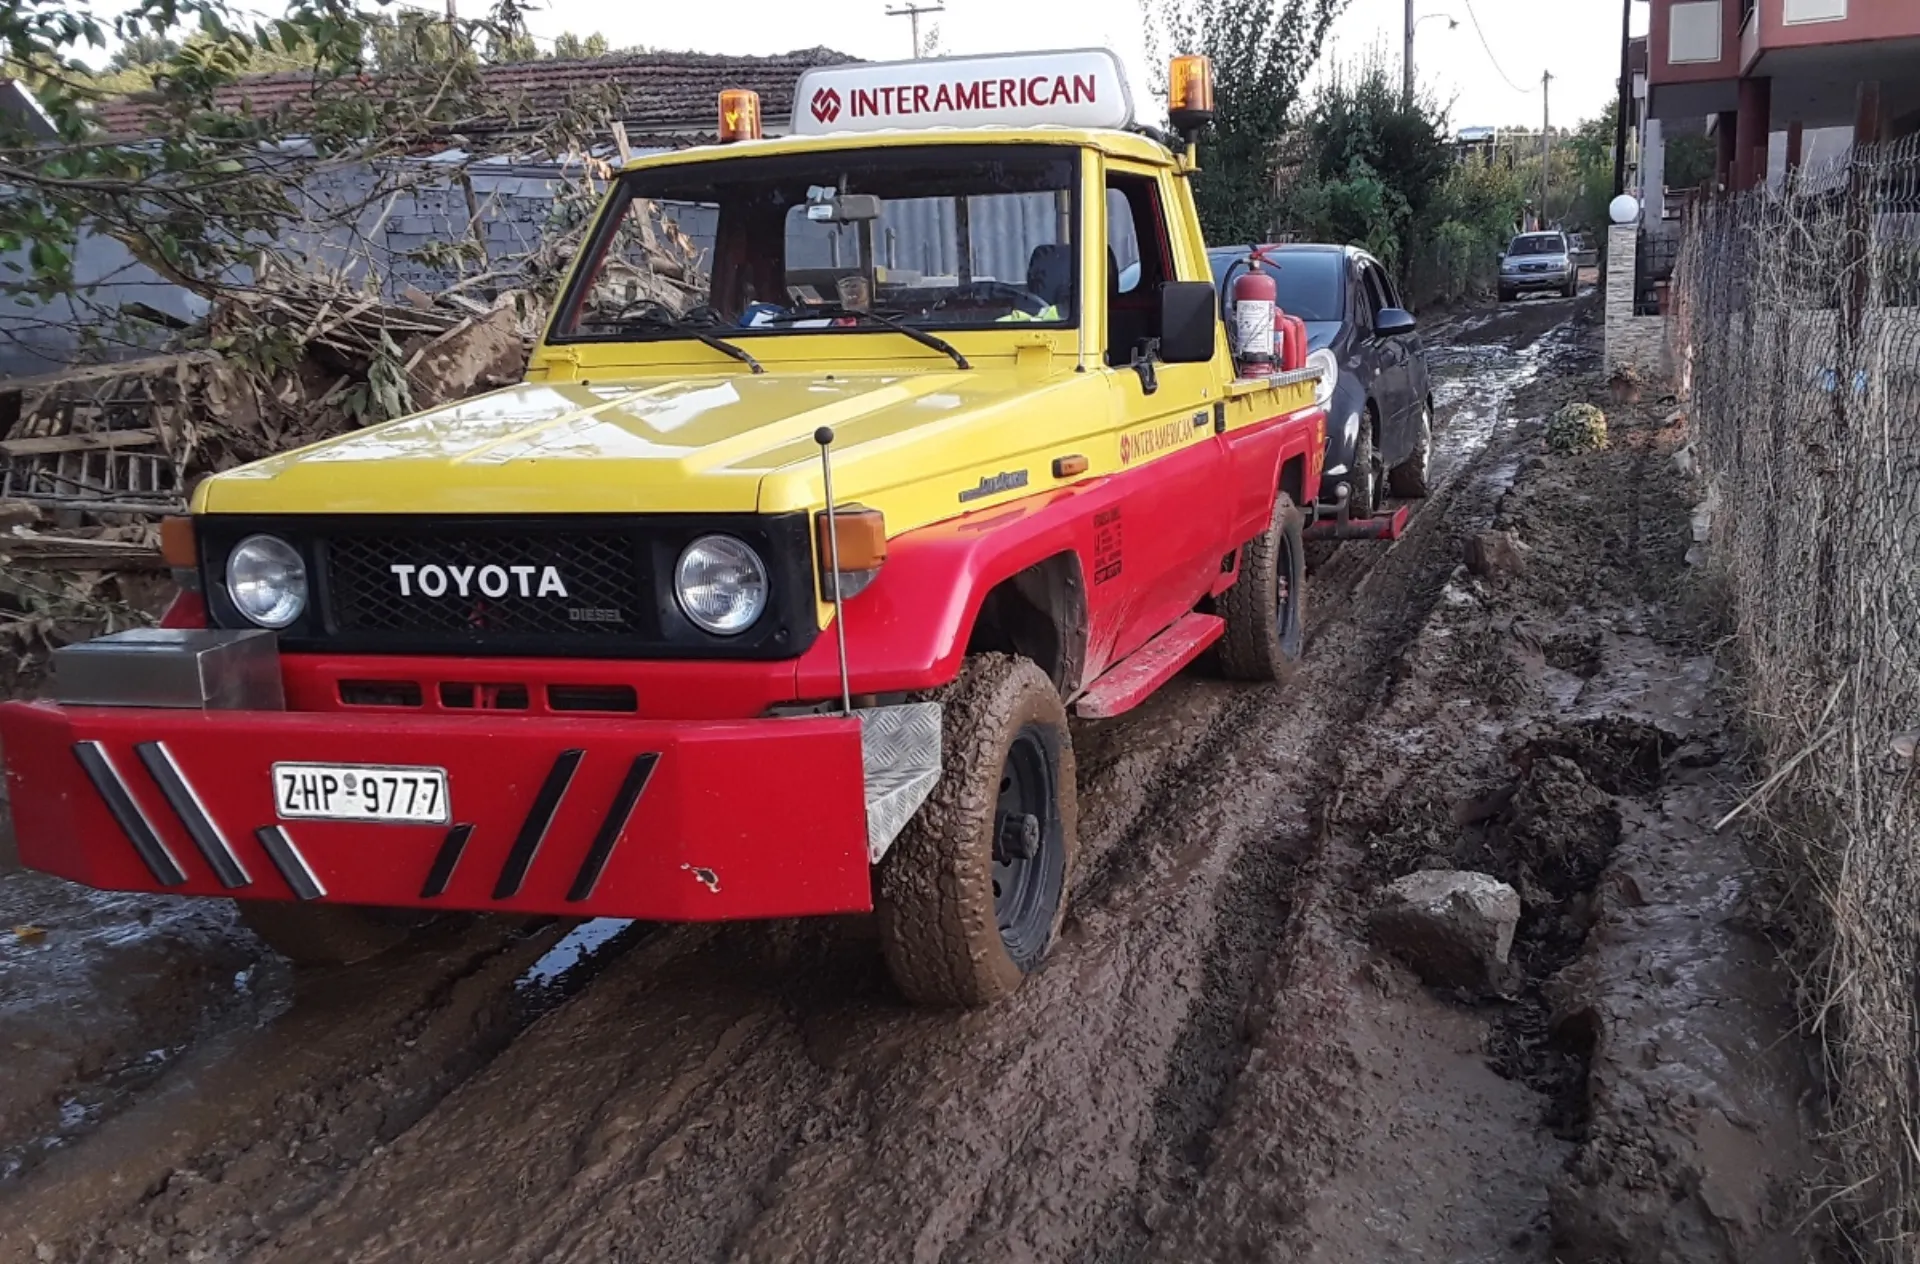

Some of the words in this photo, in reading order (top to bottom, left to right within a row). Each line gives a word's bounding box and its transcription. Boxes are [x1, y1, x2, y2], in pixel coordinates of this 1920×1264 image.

[850, 73, 1096, 118] INTERAMERICAN
[1130, 417, 1194, 459] INTERAMERICAN
[390, 564, 569, 598] TOYOTA
[568, 606, 625, 623] DIESEL
